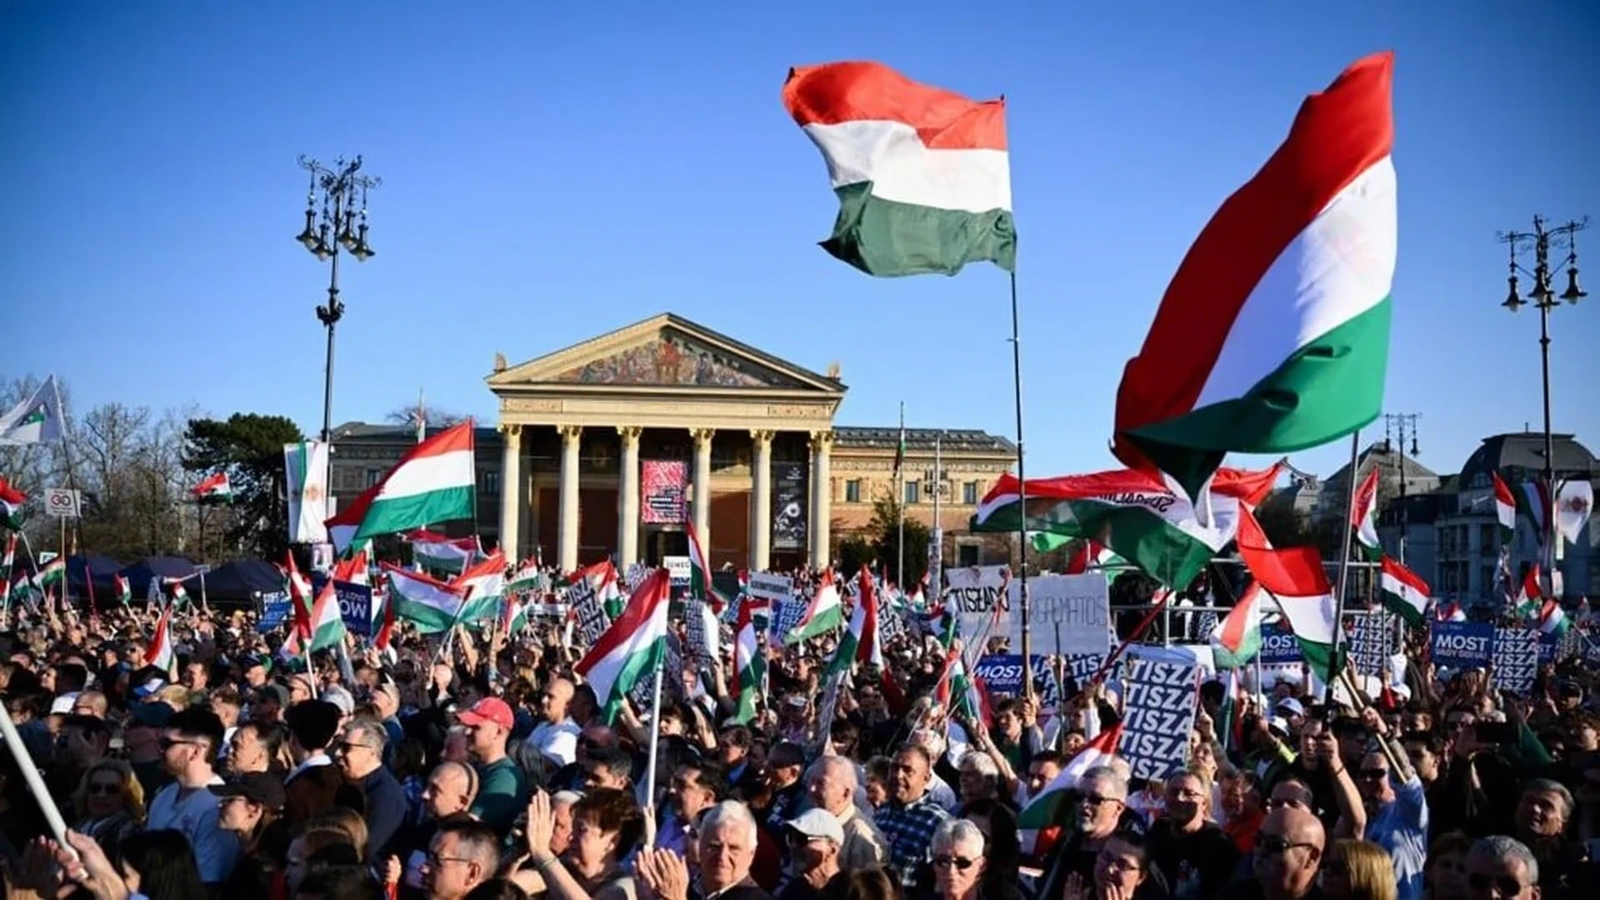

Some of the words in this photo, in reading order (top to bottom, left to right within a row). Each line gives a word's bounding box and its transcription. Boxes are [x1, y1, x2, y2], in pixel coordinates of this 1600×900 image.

[1436, 635, 1488, 651] MOST
[1131, 660, 1197, 687] TISZA
[1127, 682, 1195, 712] TISZA
[1123, 706, 1191, 736] TISZA
[1120, 730, 1187, 760] TISZA
